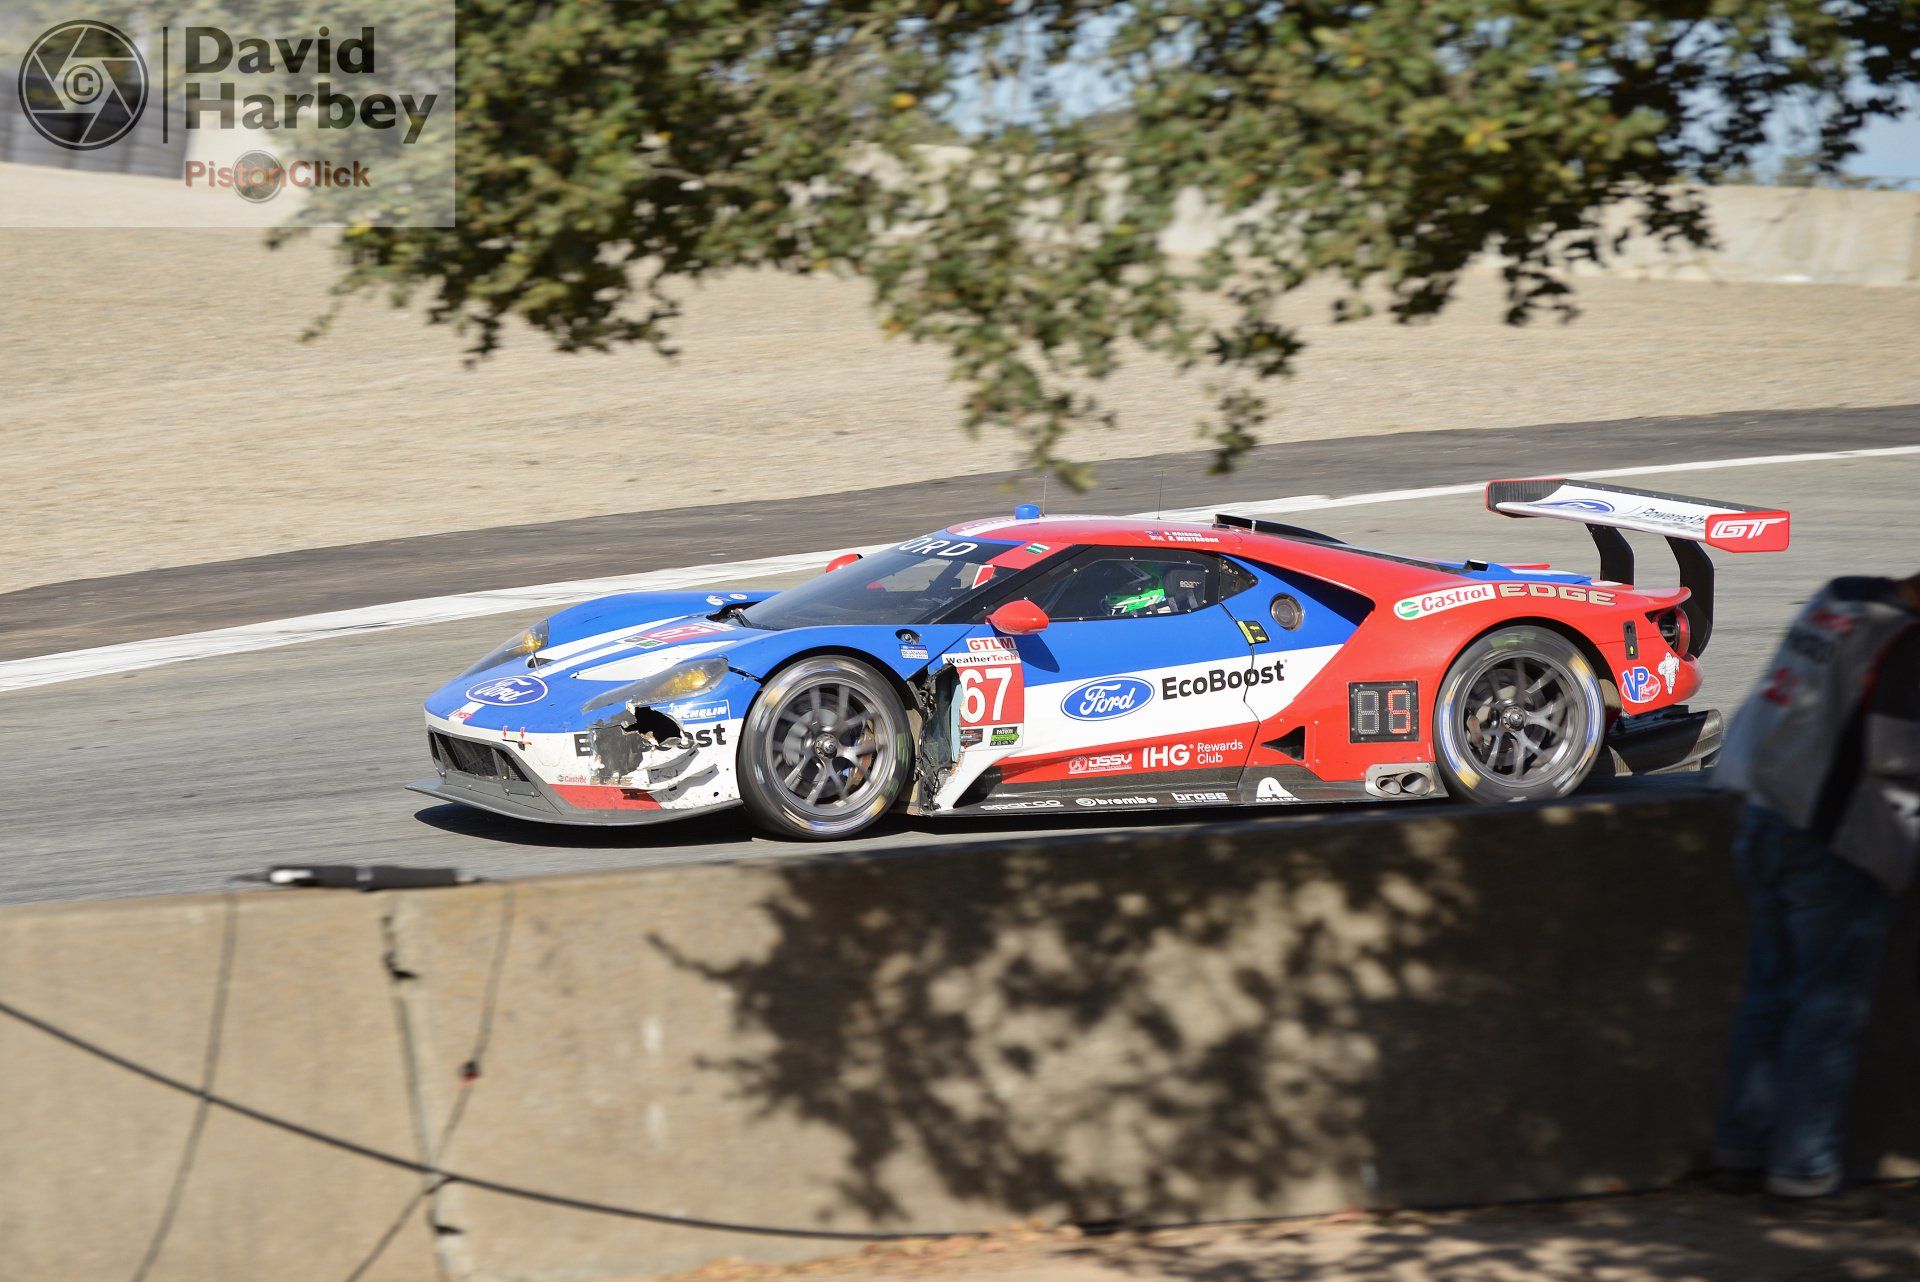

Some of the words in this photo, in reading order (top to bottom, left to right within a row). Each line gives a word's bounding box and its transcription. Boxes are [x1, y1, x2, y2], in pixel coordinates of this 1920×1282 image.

[1711, 518, 1788, 539] GT
[899, 536, 978, 557] ORD
[1421, 586, 1490, 611] Castrol
[1498, 583, 1616, 606] EDGE
[969, 637, 1014, 651] GTLM
[946, 654, 1017, 664] WeatherTech
[1162, 660, 1285, 701] EcoBoost
[1622, 666, 1649, 702] VP
[960, 668, 1012, 724] 67
[1079, 683, 1136, 715] Ford
[1197, 739, 1243, 753] Rewards
[1197, 753, 1223, 764] Club
[1095, 796, 1158, 805] brembo
[1171, 792, 1229, 801] brose
